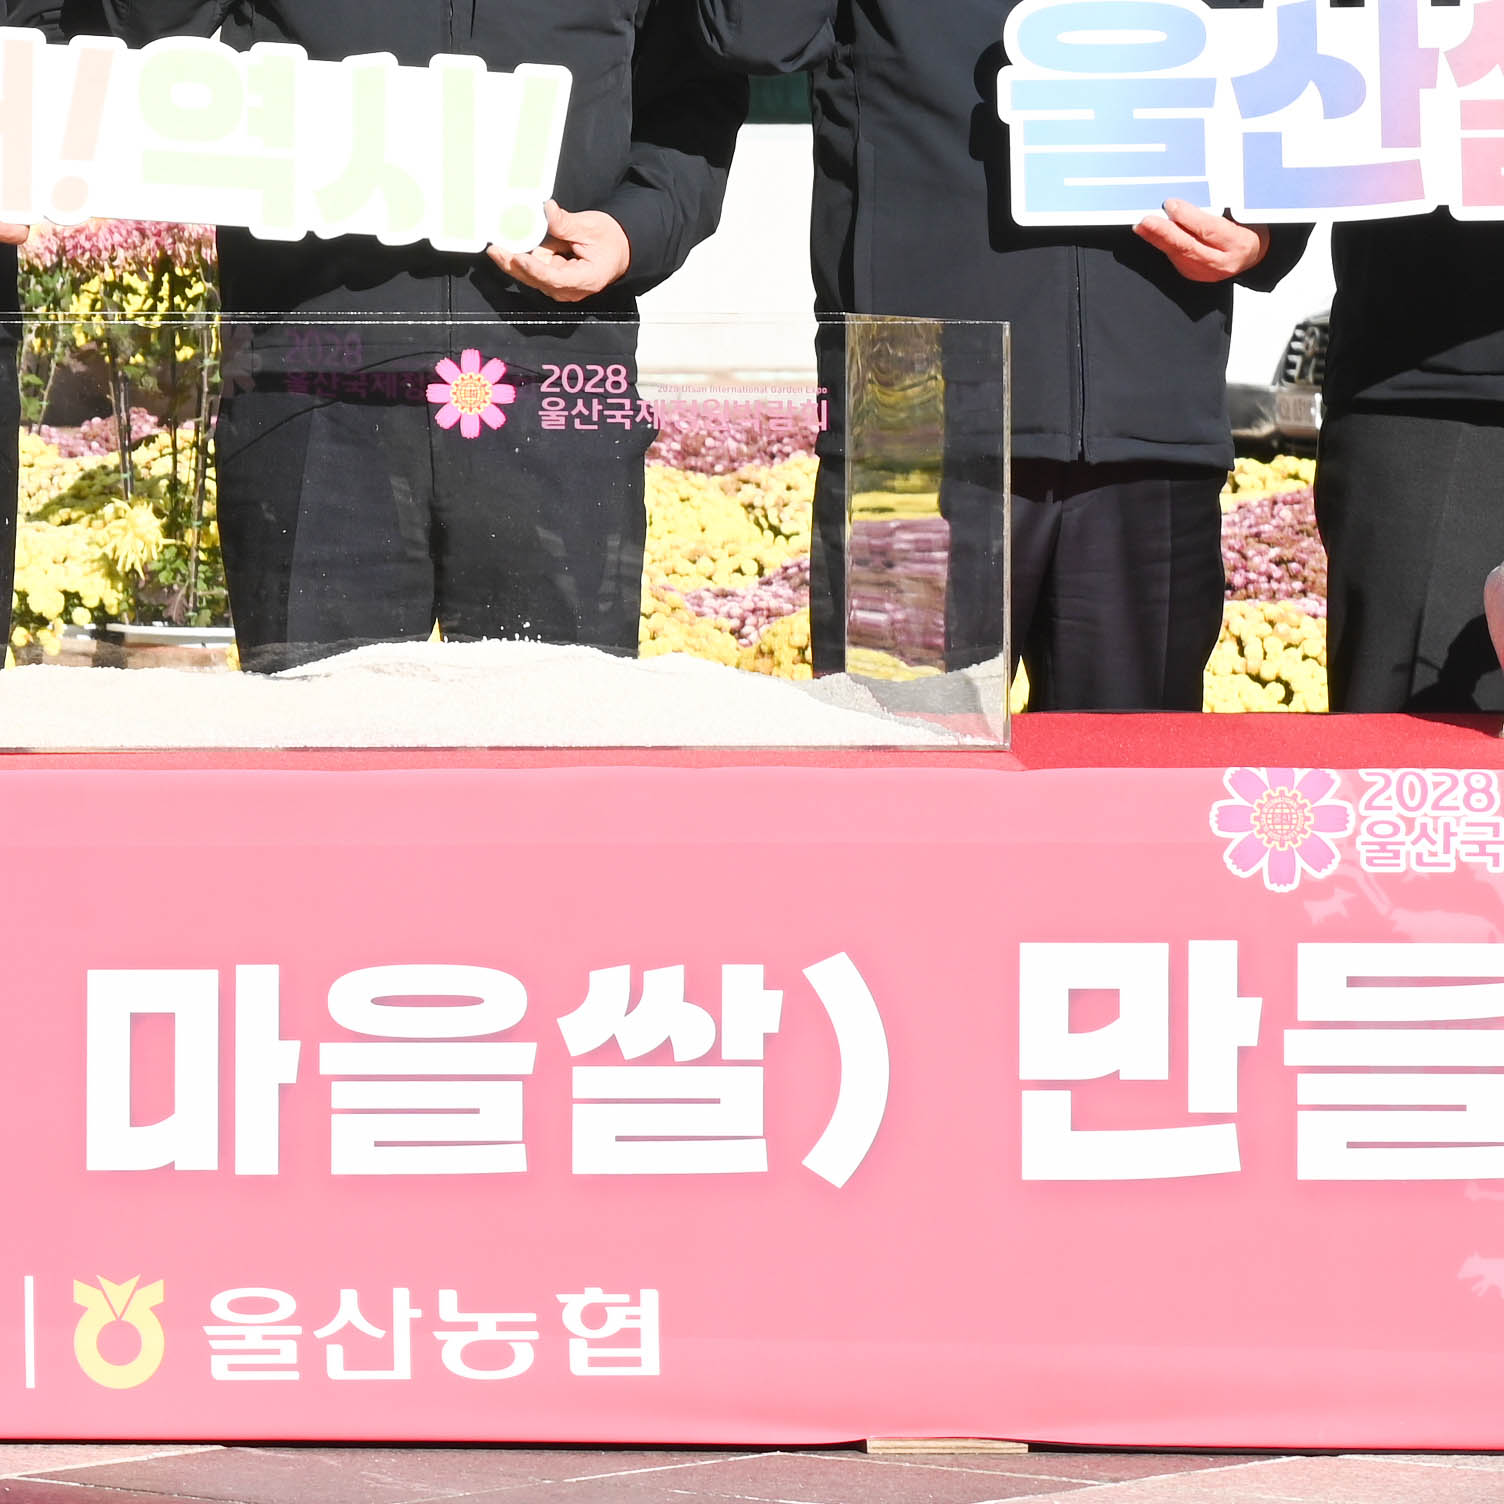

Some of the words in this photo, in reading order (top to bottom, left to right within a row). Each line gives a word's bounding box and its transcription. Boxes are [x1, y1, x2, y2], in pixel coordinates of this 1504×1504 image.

[140, 48, 558, 241] 역시!
[539, 363, 628, 393] 2028
[1359, 769, 1497, 814] 2028
[87, 951, 890, 1188] 마을쌀)
[1019, 939, 1504, 1181] 만들
[203, 1284, 662, 1381] 울산농협
